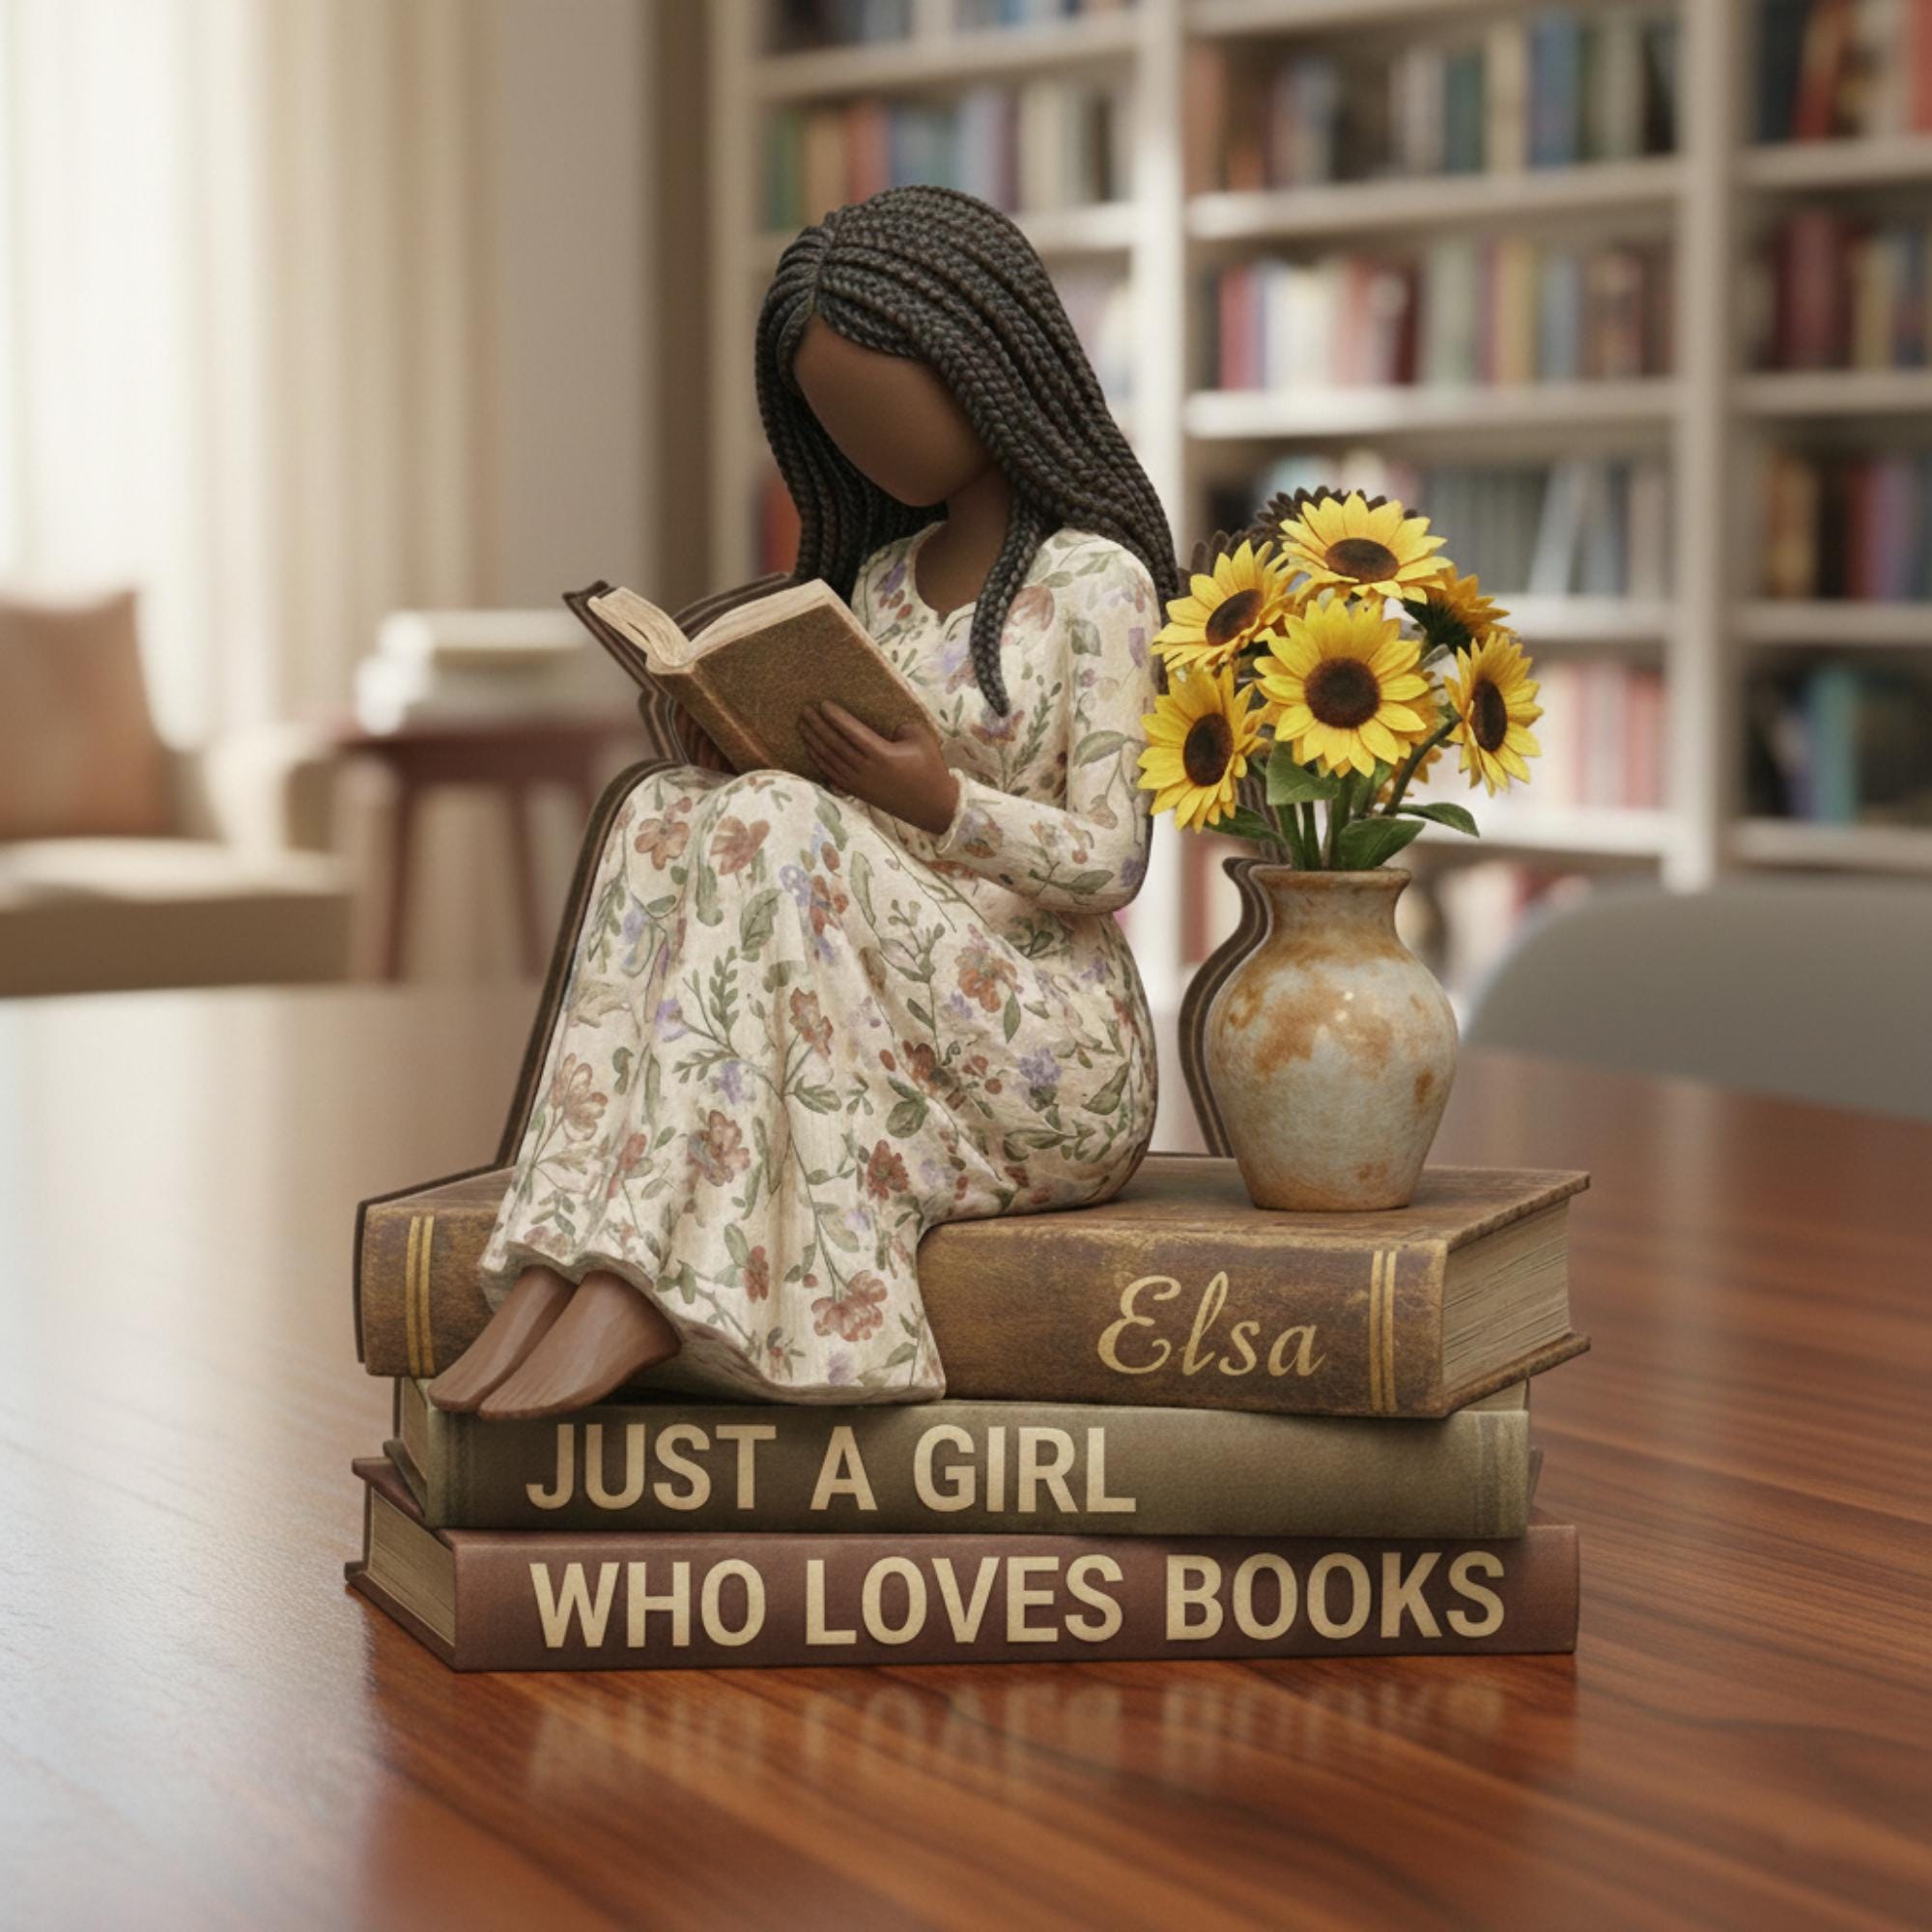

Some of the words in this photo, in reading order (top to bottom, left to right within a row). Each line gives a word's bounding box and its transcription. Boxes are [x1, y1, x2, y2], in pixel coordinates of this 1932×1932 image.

[1096, 1271, 1326, 1377] Elsa
[526, 1424, 777, 1511] JUST
[810, 1426, 878, 1511] A
[913, 1426, 1137, 1514] GIRL
[529, 1559, 767, 1649] WHO
[805, 1554, 1124, 1646] LOVES
[1165, 1550, 1506, 1642] BOOKS
